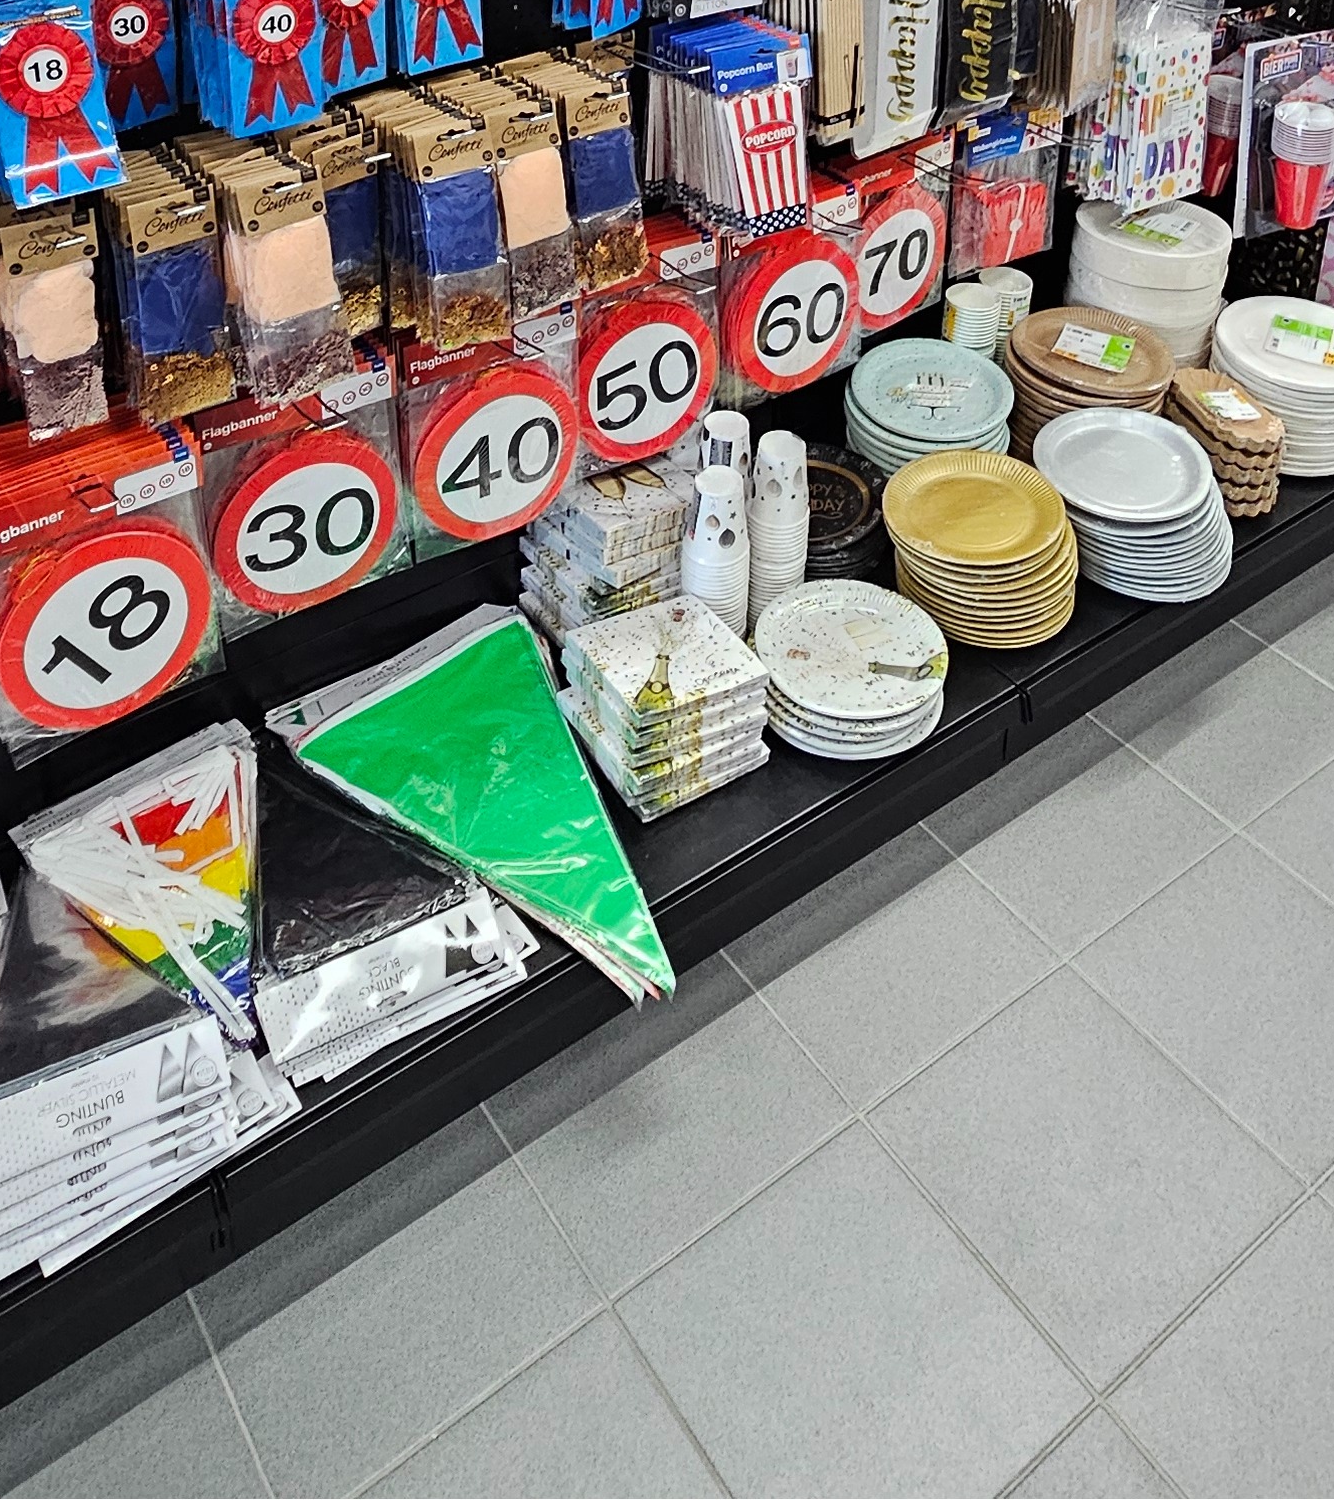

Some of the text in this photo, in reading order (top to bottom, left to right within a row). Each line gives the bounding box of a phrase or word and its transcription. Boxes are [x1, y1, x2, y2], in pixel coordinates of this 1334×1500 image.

[113, 13, 147, 38] 30
[261, 13, 295, 36] 40
[27, 57, 66, 84] 18
[717, 60, 775, 82] Popcorn Box
[575, 100, 622, 124] Confetti
[501, 121, 551, 146] Confetti
[744, 125, 798, 148] POPCORN
[428, 137, 484, 165] Confetti
[1144, 131, 1194, 181] DAY
[253, 188, 315, 217] Confetti
[144, 210, 206, 238] Confetti
[863, 228, 929, 299] 70
[757, 282, 845, 358] 60
[409, 344, 477, 374] Flagbanner
[595, 340, 698, 432] 50
[201, 407, 279, 441] Flagbanner
[440, 416, 560, 499] 40
[244, 487, 375, 572] 30
[41, 574, 170, 687] 18
[55, 1089, 126, 1129] BUNTING
